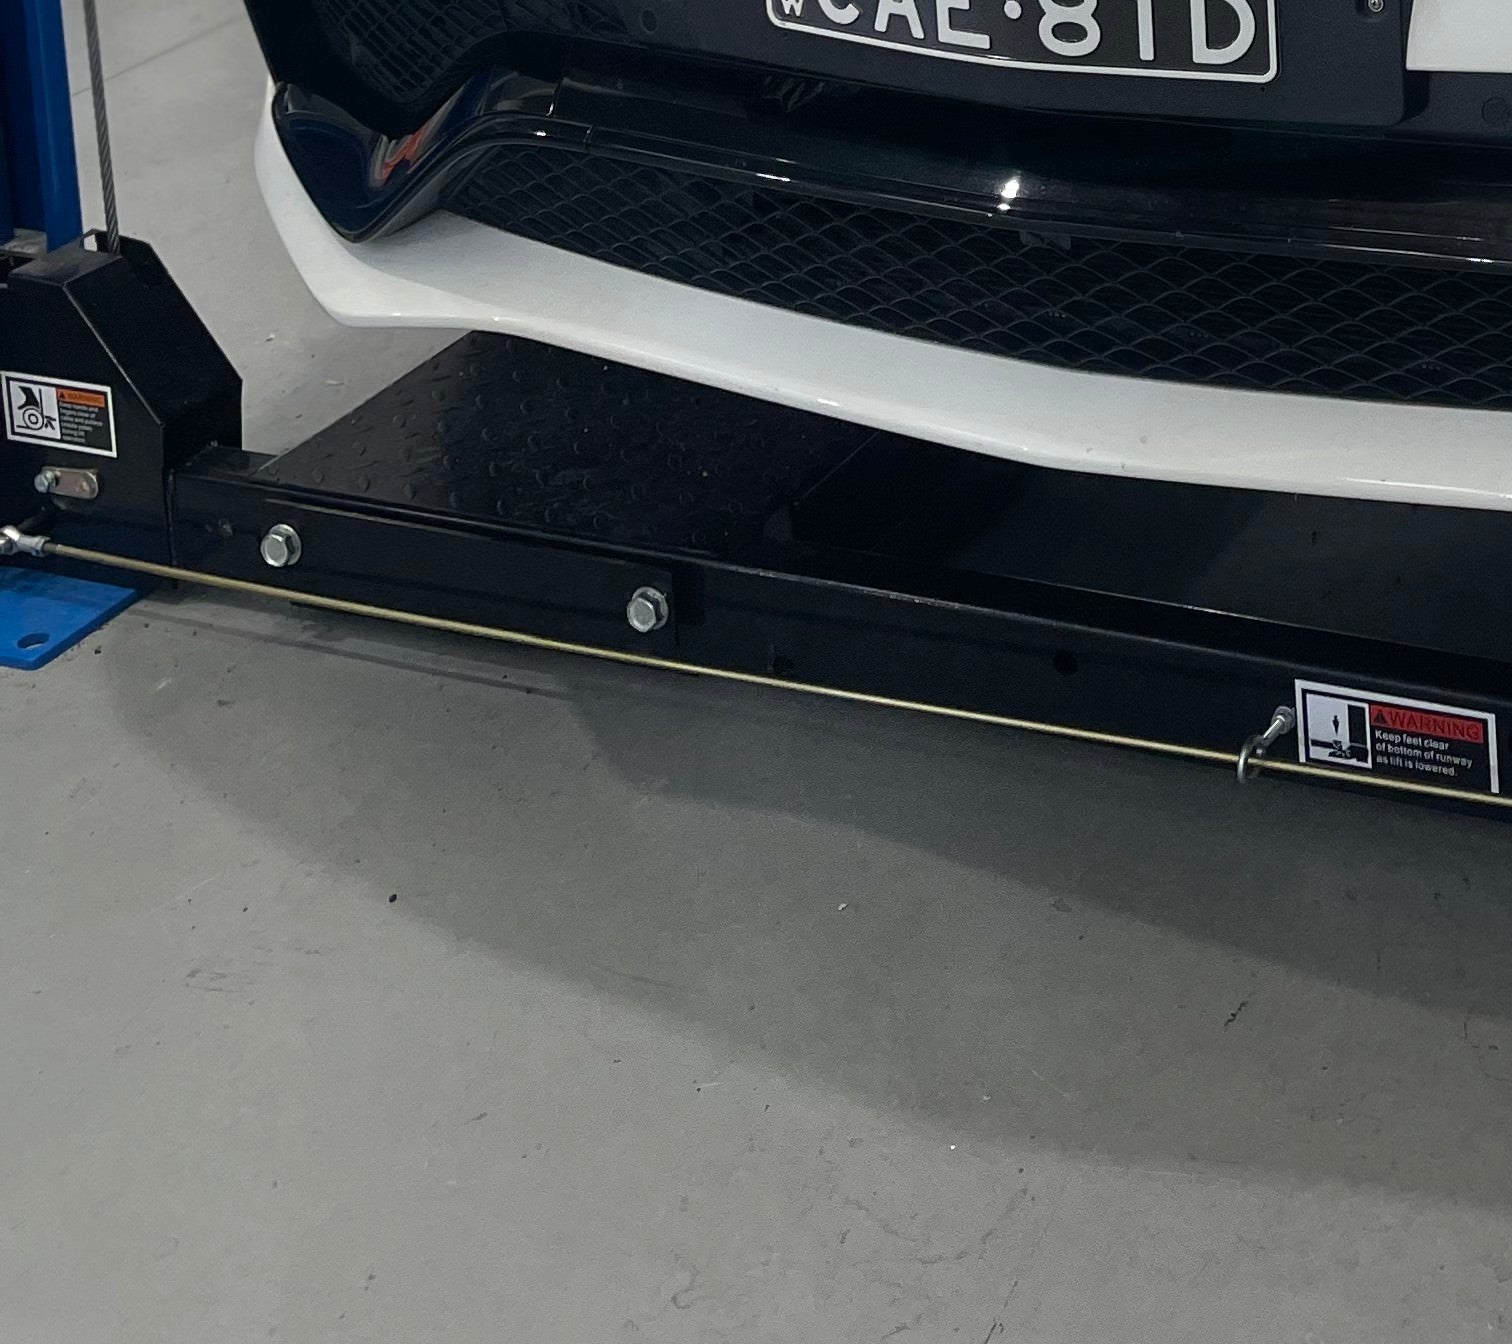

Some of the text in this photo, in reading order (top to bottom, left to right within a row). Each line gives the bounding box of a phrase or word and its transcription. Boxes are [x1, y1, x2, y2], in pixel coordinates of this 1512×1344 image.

[1388, 710, 1480, 740] WARNING
[1375, 729, 1449, 751] Keep feet clear
[1375, 742, 1473, 769] of bottom of runway
[1376, 755, 1388, 765] as
[1389, 755, 1403, 768] lift
[1404, 758, 1414, 769] is
